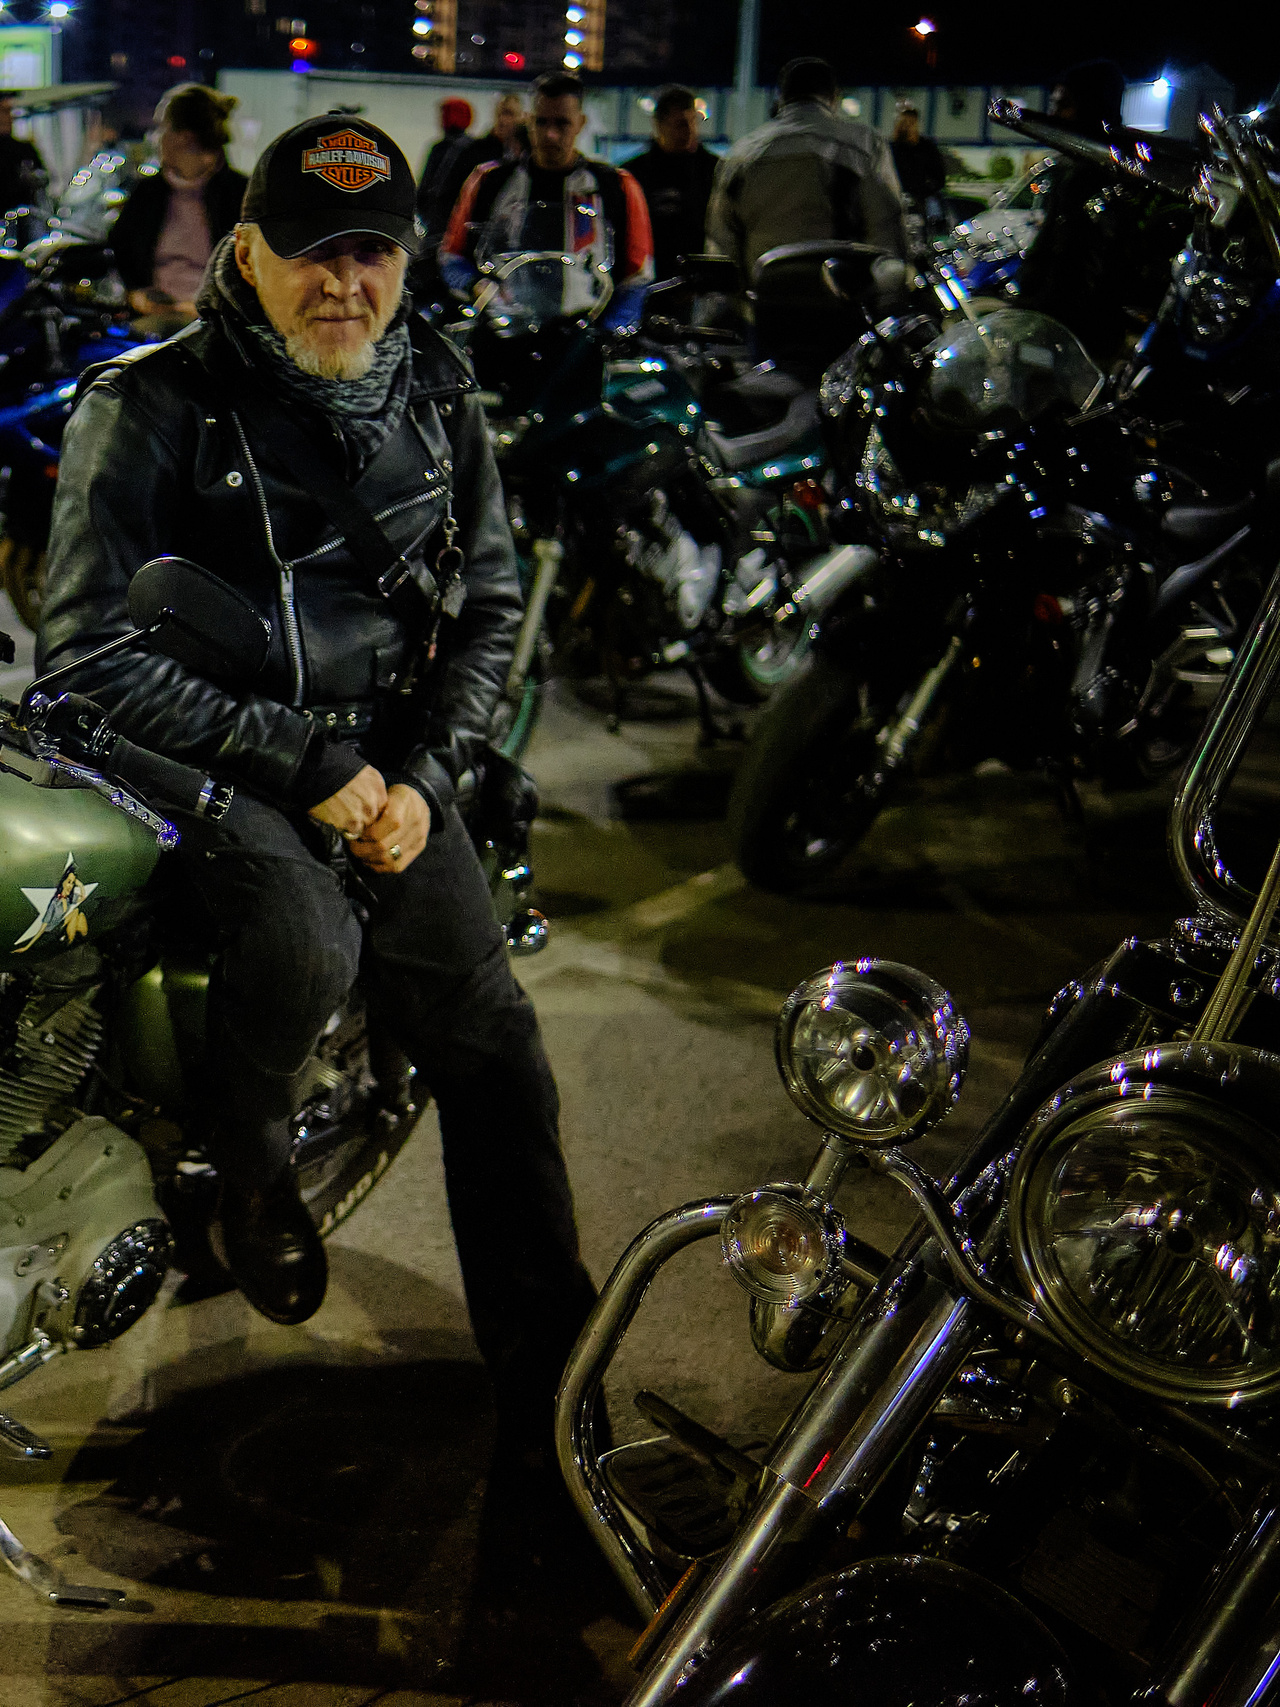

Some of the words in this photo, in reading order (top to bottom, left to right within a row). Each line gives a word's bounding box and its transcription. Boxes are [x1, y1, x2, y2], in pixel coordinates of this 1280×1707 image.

[327, 135, 371, 150] MOTOR
[308, 150, 388, 172] HARLEY-DAVIDSON
[327, 166, 372, 185] CYCLES
